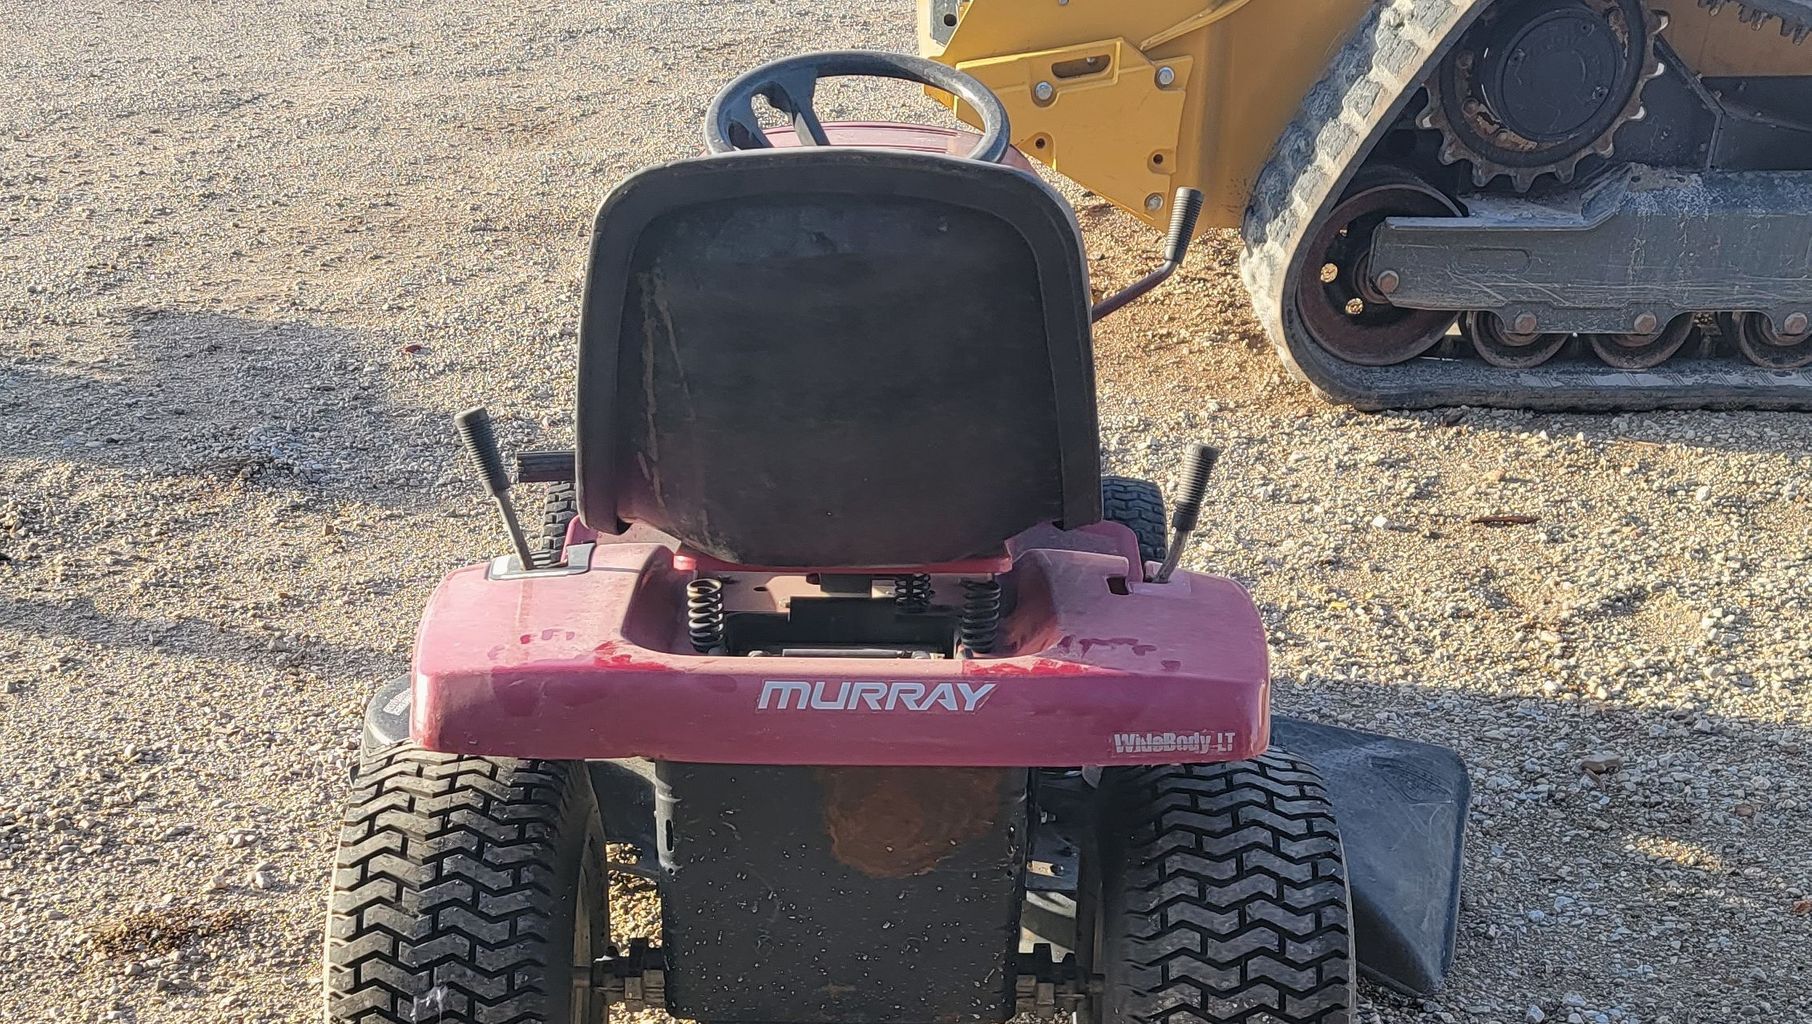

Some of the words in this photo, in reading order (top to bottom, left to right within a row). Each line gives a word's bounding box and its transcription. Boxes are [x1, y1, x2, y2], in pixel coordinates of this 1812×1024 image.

[757, 681, 996, 711] MURRAY
[1113, 733, 1211, 754] WideBody
[1217, 733, 1236, 752] LT
